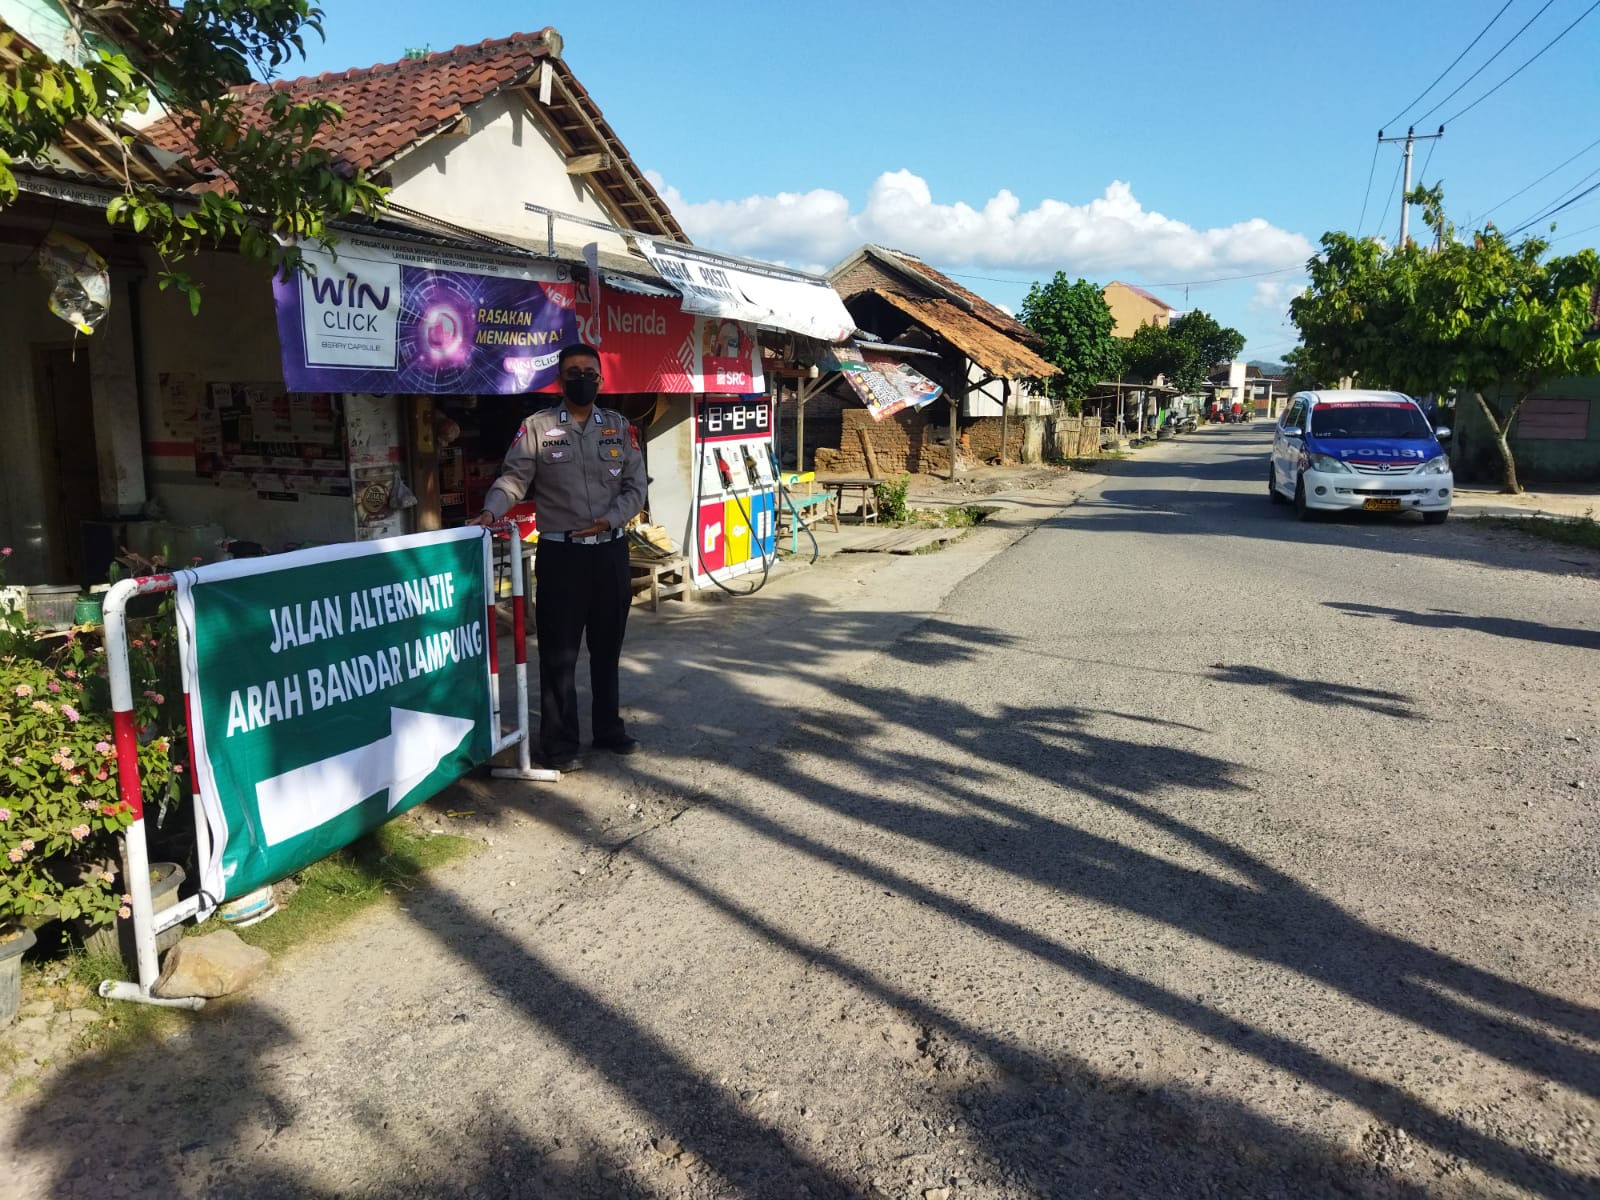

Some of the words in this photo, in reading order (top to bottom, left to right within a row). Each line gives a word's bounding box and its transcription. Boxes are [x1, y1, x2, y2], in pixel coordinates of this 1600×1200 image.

[60, 187, 96, 202] KANKER
[698, 266, 732, 290] PASTI
[312, 272, 390, 311] WIN
[545, 286, 573, 307] NEW
[323, 311, 377, 332] CLICK
[477, 308, 532, 326] RASAKAN
[607, 305, 667, 335] Nenda
[321, 341, 346, 350] BERRY
[347, 343, 381, 352] CAPSULE
[475, 329, 563, 346] MENANGNYA!
[726, 372, 746, 386] SRC
[1340, 448, 1425, 459] POLISI
[269, 595, 344, 654] JALAN
[350, 571, 455, 633] ALTERNATIF
[226, 673, 304, 738] ARAH
[307, 646, 403, 711] BANDAR
[404, 620, 482, 679] LAMPUNG
